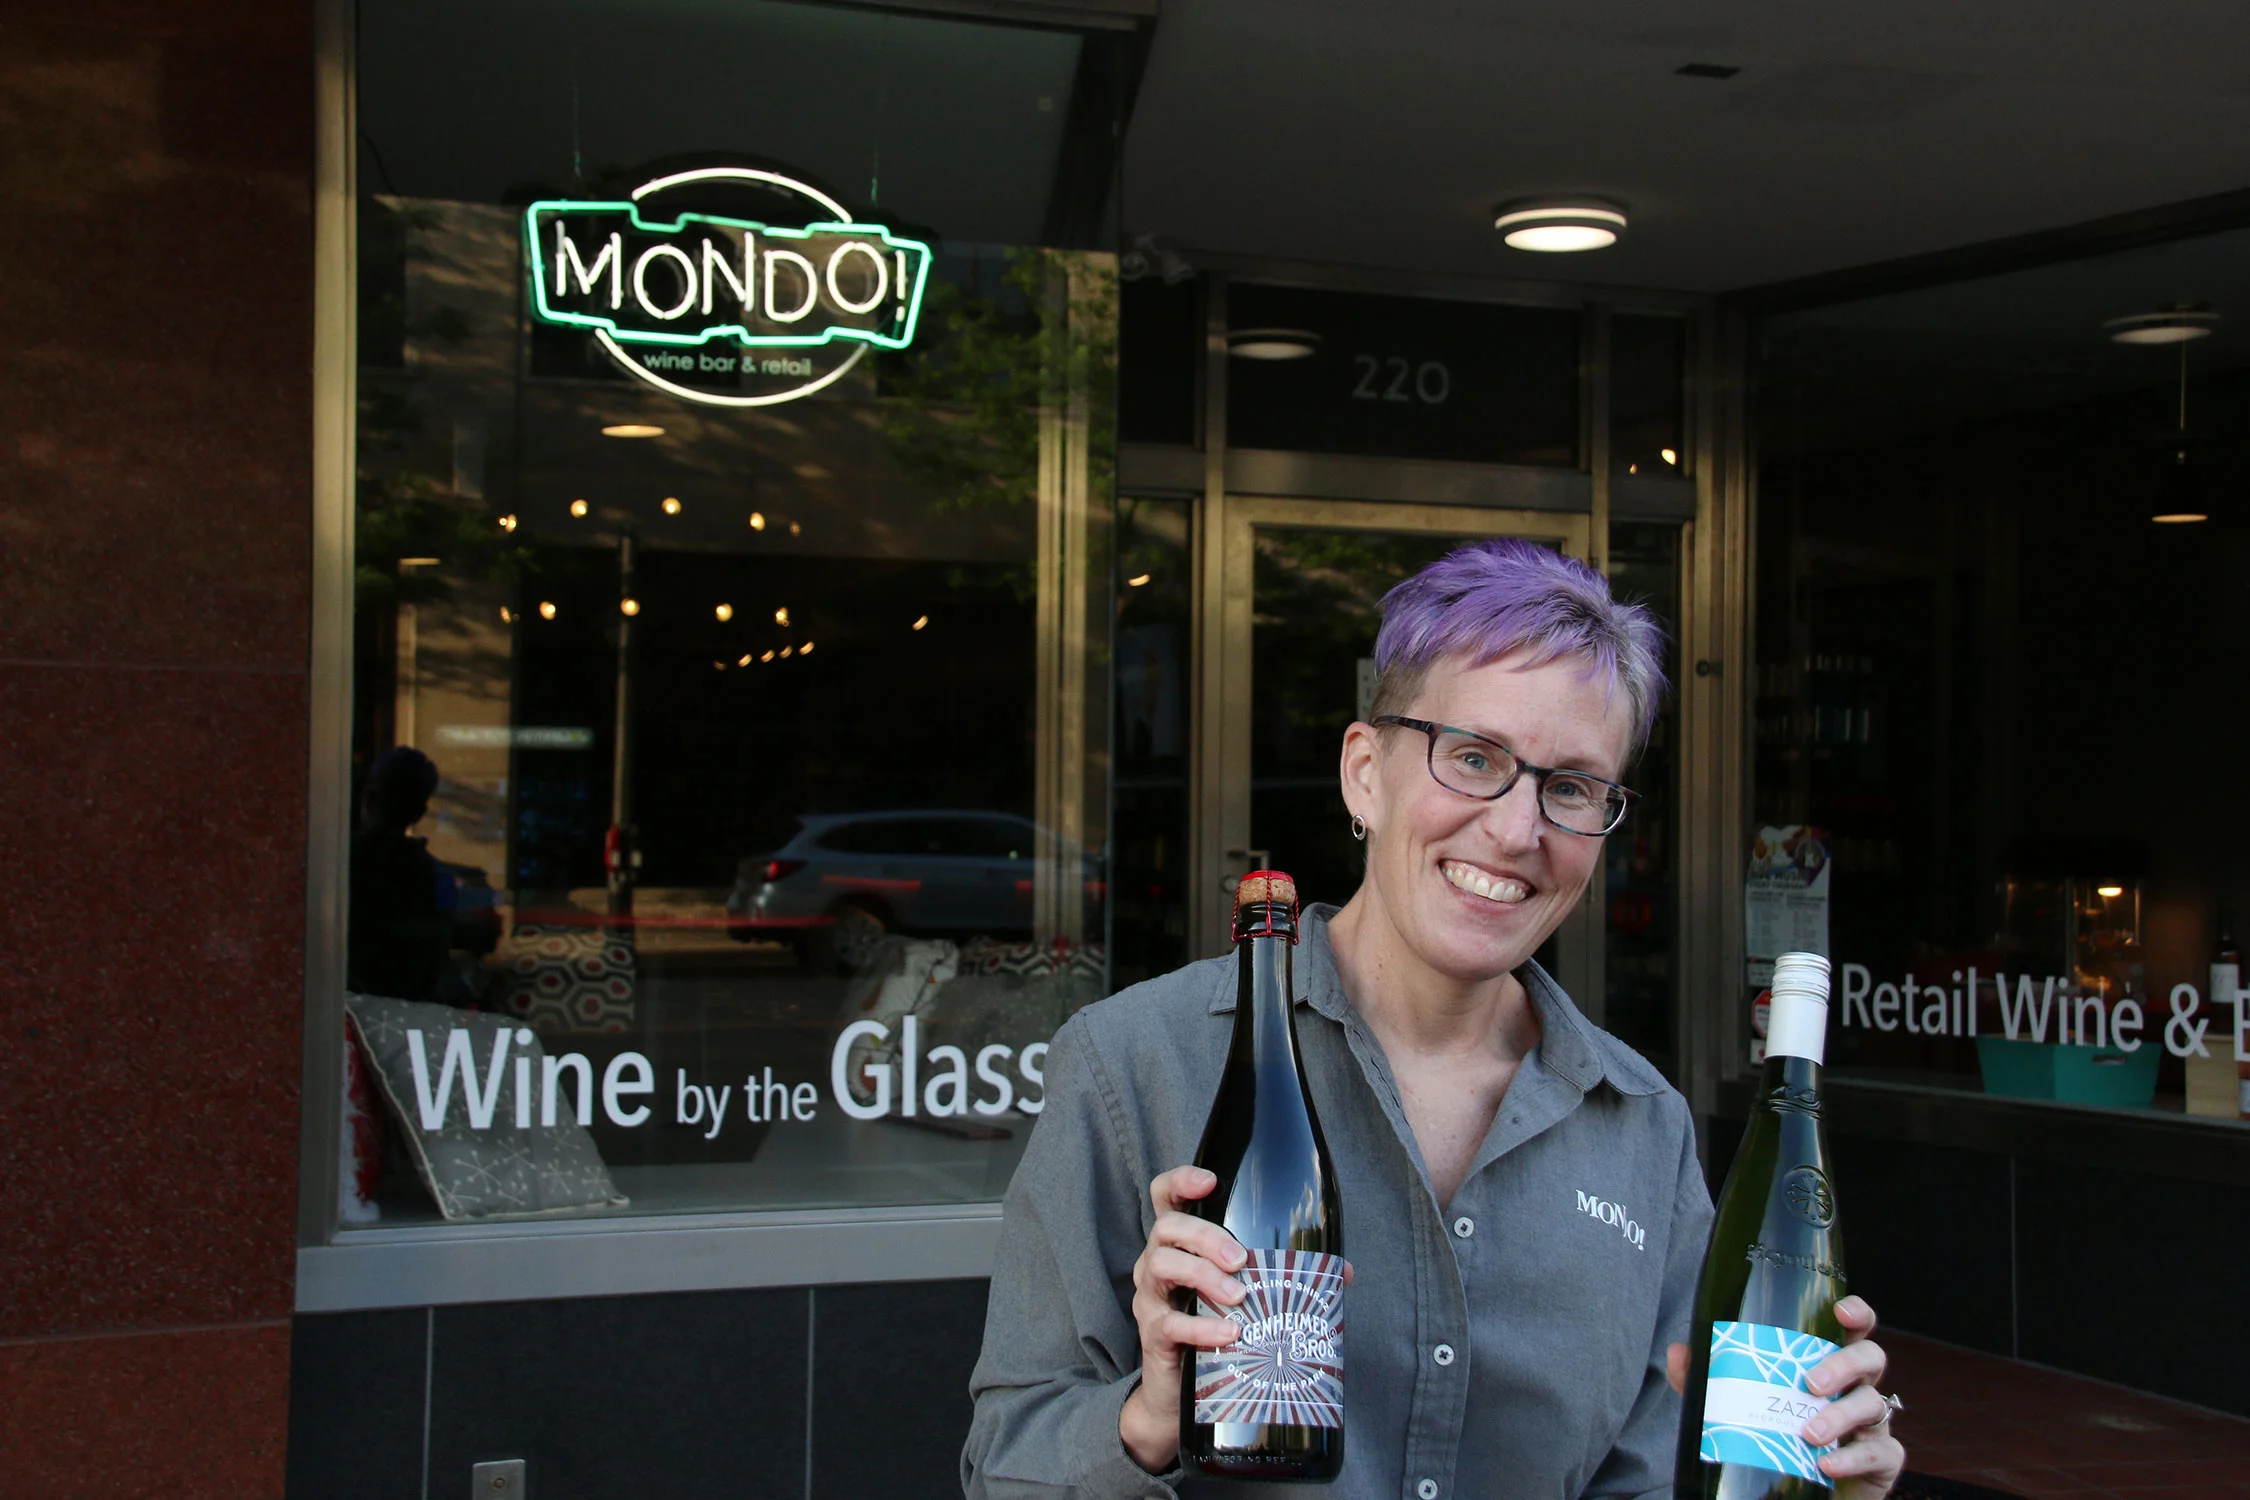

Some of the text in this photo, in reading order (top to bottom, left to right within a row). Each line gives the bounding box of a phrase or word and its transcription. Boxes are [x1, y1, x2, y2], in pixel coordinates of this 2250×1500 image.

[555, 219, 907, 323] MONDO!
[643, 351, 812, 377] wine bar & retail
[1352, 353, 1450, 404] 220
[1842, 963, 1977, 1037] Retail
[1995, 972, 2144, 1053] Wine
[2164, 983, 2211, 1058] &
[406, 1015, 1050, 1139] Wine by the Glass
[1576, 1189, 1645, 1251] MONO!
[1246, 1279, 1330, 1312] RKLING SHIRAZ
[1227, 1311, 1331, 1348] GENHEIMER
[1227, 1363, 1326, 1391] OUT OF THE PARK
